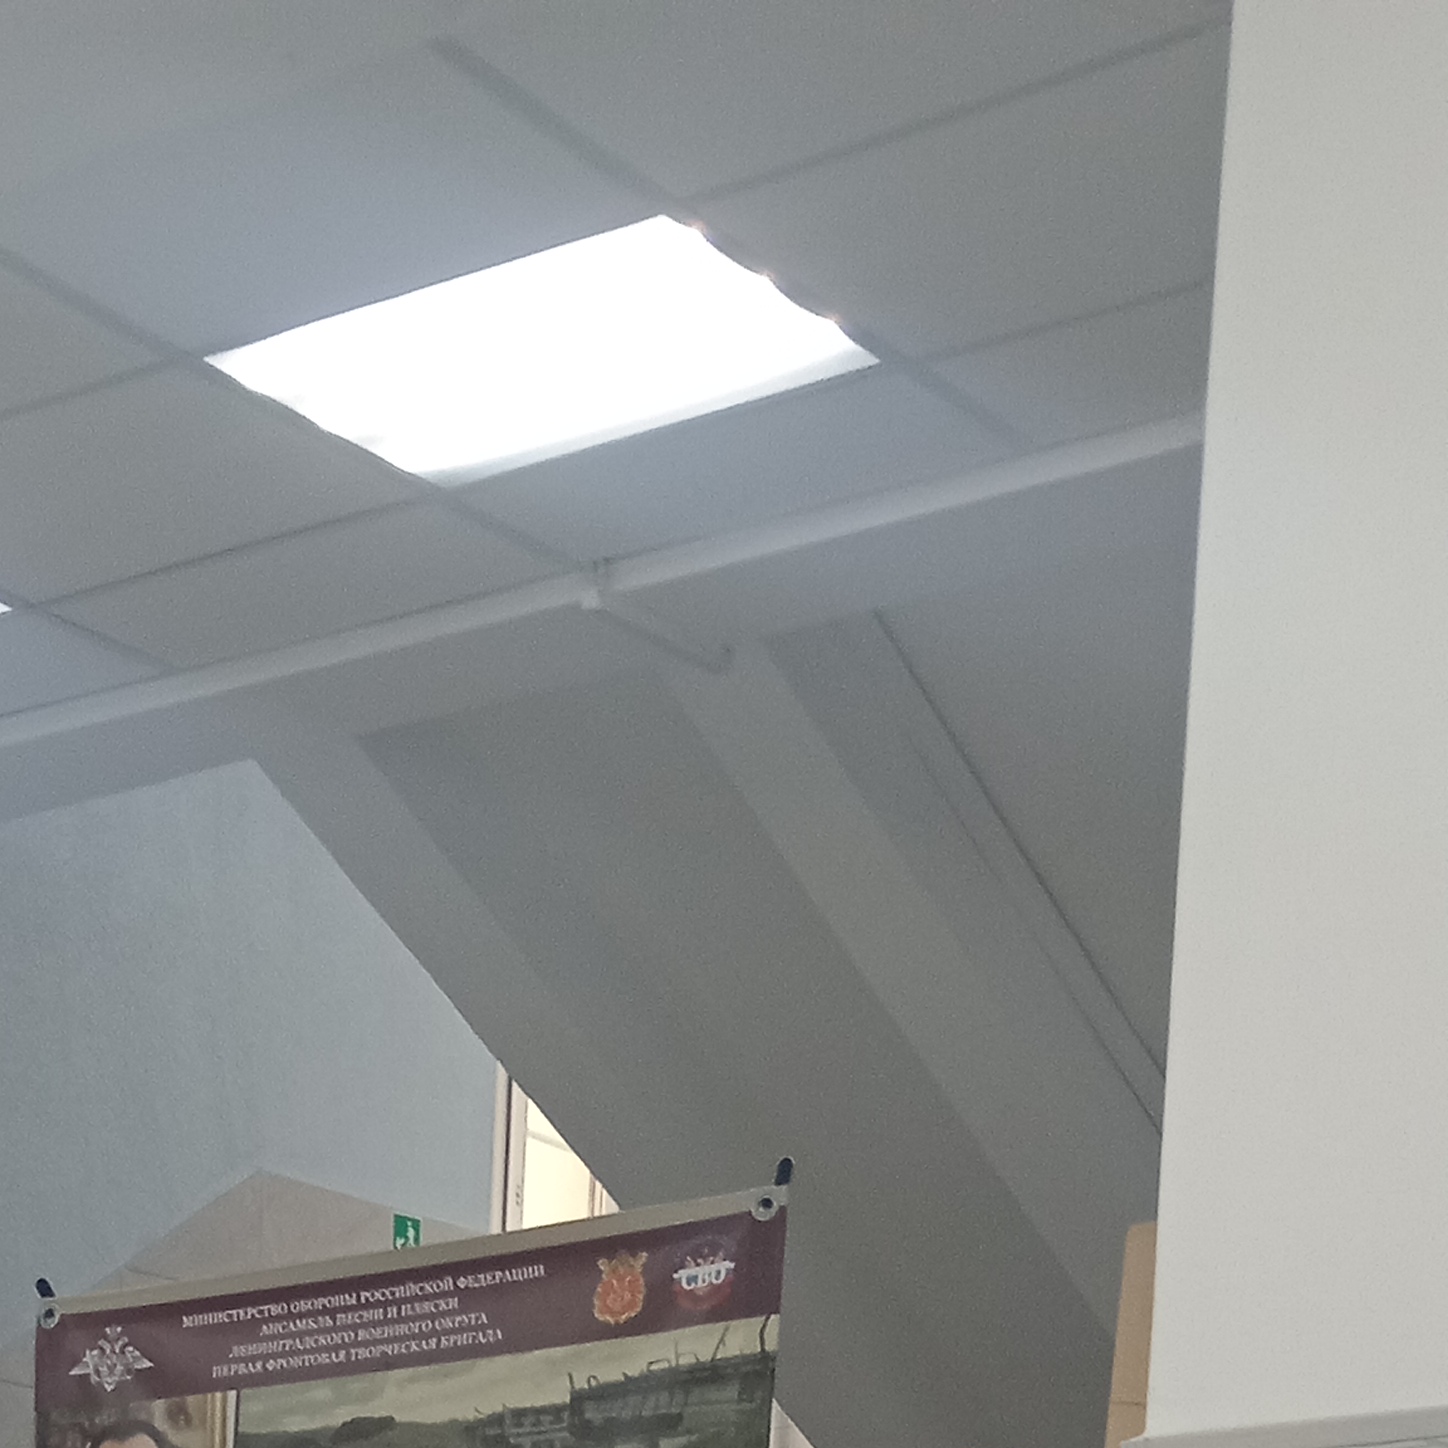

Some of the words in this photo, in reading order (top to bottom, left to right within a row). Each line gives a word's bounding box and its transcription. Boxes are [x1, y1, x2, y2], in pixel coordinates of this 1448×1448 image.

[182, 1303, 288, 1328] МИНИСТЕРСТВО
[290, 1292, 357, 1313] ОБОРОНЫ
[360, 1277, 454, 1304] РОССИЙСКОЙ
[456, 1264, 545, 1289] ФЕДЕРАЦИИ
[336, 1308, 384, 1326] ПЕСНИ
[387, 1306, 397, 1318] И
[212, 1360, 263, 1378] ПЕРВАЯ
[265, 1350, 346, 1372] ФРОНТОВАЯ
[350, 1337, 437, 1360] ТВОРЧЕСКАЯ
[440, 1328, 503, 1349] БРИГАДА
[229, 1330, 354, 1358] ЛЕНИНГРАДСКОГО
[357, 1320, 432, 1341] ВОЕННОГО
[435, 1312, 489, 1331] ОКРУГА
